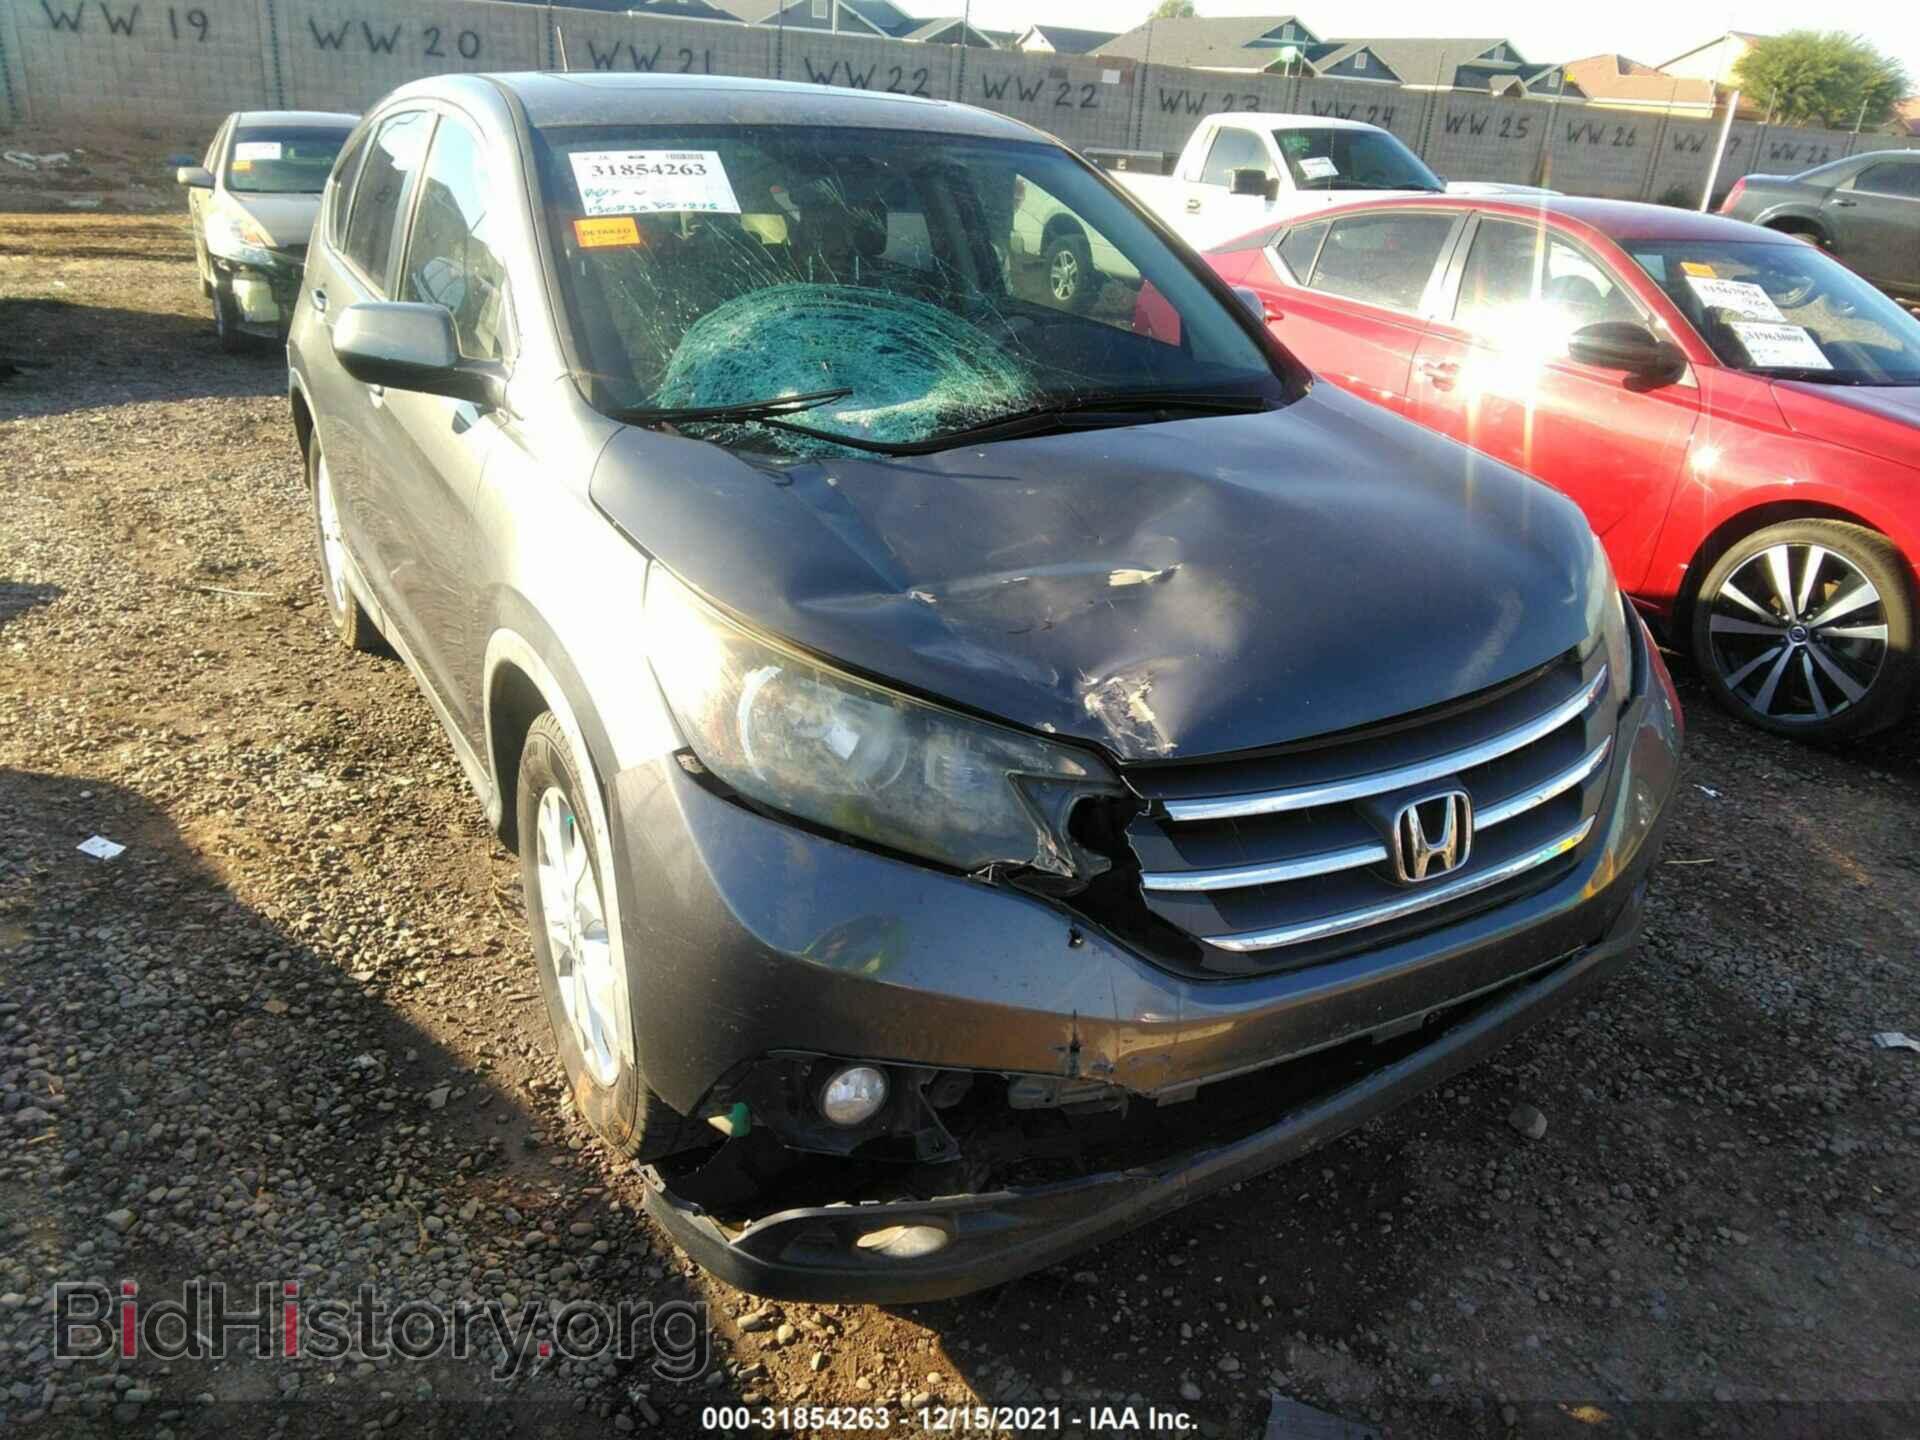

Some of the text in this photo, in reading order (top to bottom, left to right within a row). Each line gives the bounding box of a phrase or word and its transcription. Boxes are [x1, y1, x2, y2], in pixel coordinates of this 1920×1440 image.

[167, 7, 211, 43] 19
[423, 26, 482, 60] 20
[677, 48, 712, 74] 21
[886, 65, 930, 98] 22
[1054, 82, 1100, 110] 22
[1158, 86, 1208, 116] WW
[1366, 105, 1395, 128] 24
[1443, 111, 1531, 139] WW 25
[1566, 119, 1637, 148] WW 26
[592, 162, 708, 177] 31854263
